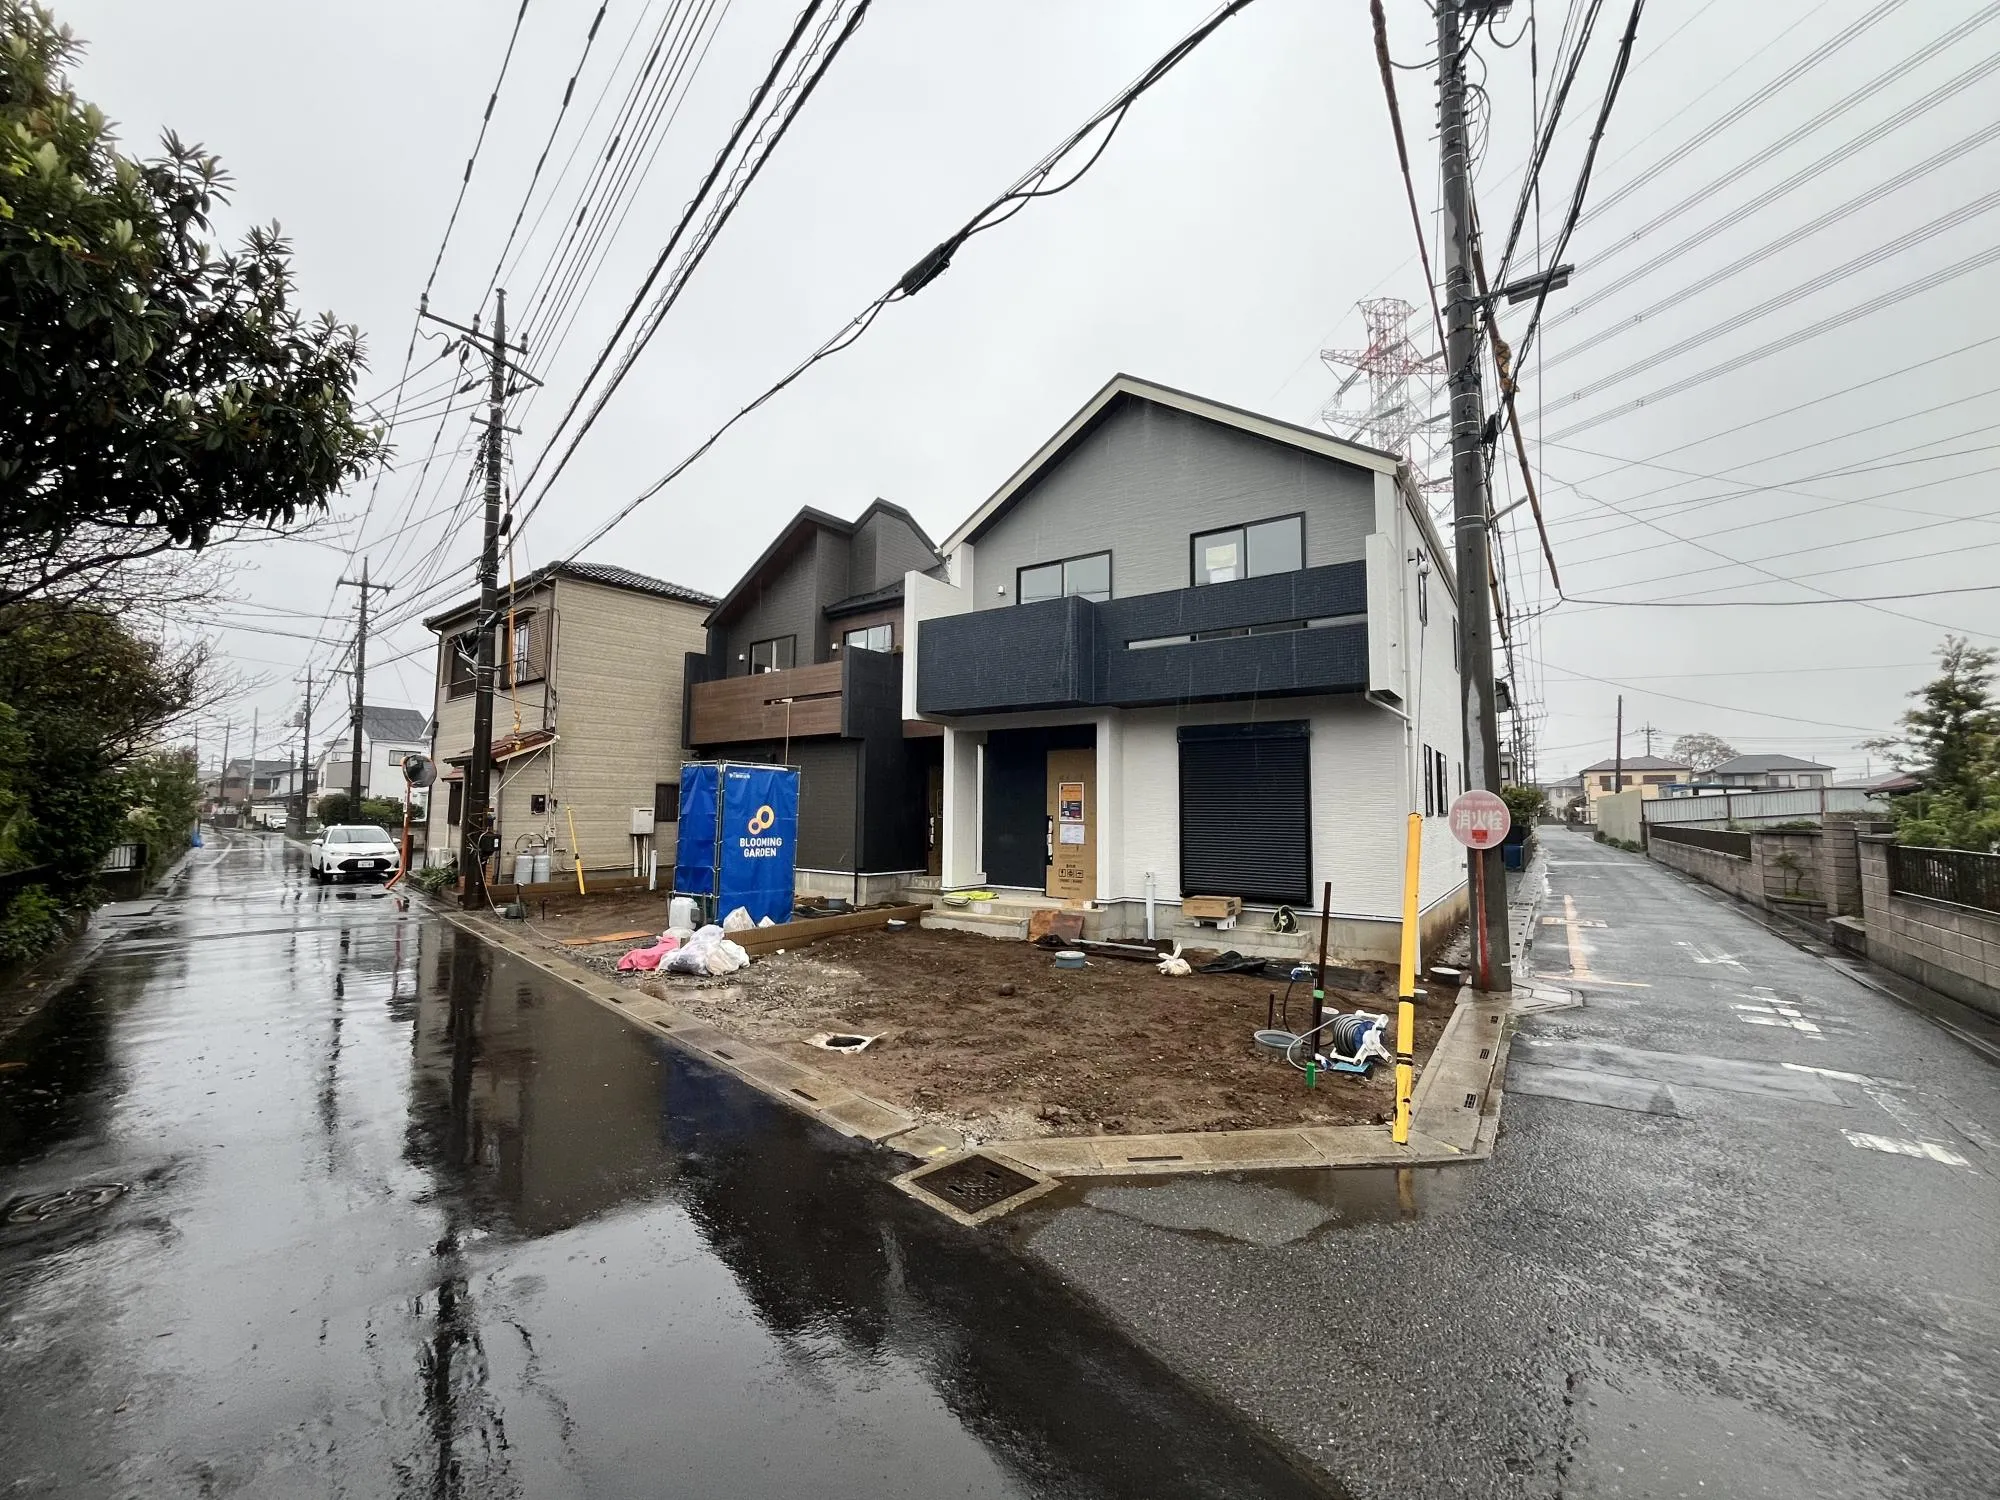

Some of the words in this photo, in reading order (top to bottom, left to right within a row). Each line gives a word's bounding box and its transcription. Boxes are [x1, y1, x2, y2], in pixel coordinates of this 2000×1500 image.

[1456, 809, 1504, 831] 消火栓
[739, 837, 782, 847] BLOOMING
[744, 848, 777, 858] GARDEN
